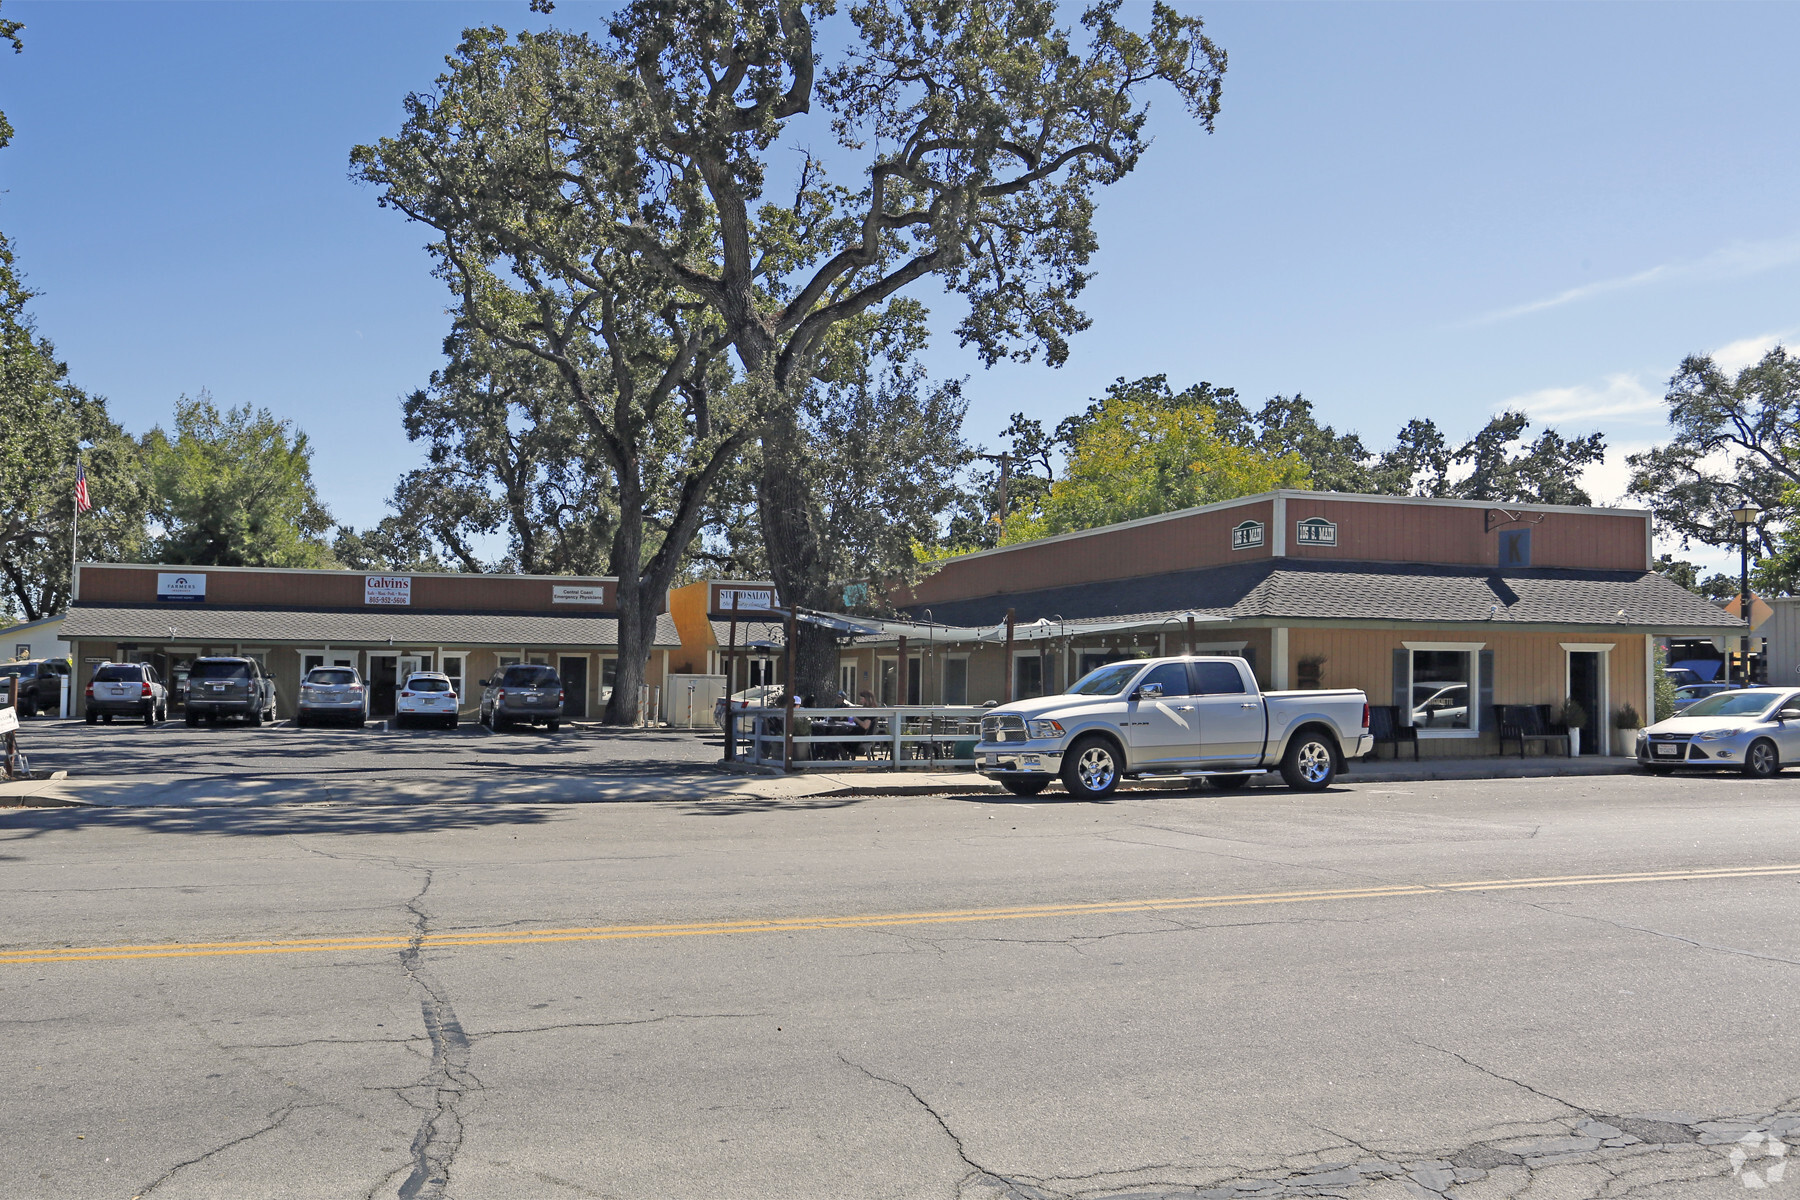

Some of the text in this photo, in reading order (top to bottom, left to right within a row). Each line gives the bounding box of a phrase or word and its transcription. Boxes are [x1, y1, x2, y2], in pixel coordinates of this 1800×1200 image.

[1234, 530, 1242, 545] 105
[1249, 527, 1262, 543] MAIN
[1300, 526, 1335, 541] 105 S. MAIN
[1509, 533, 1522, 563] K
[367, 577, 409, 589] Calvin's
[720, 590, 770, 600] STUIO SALON
